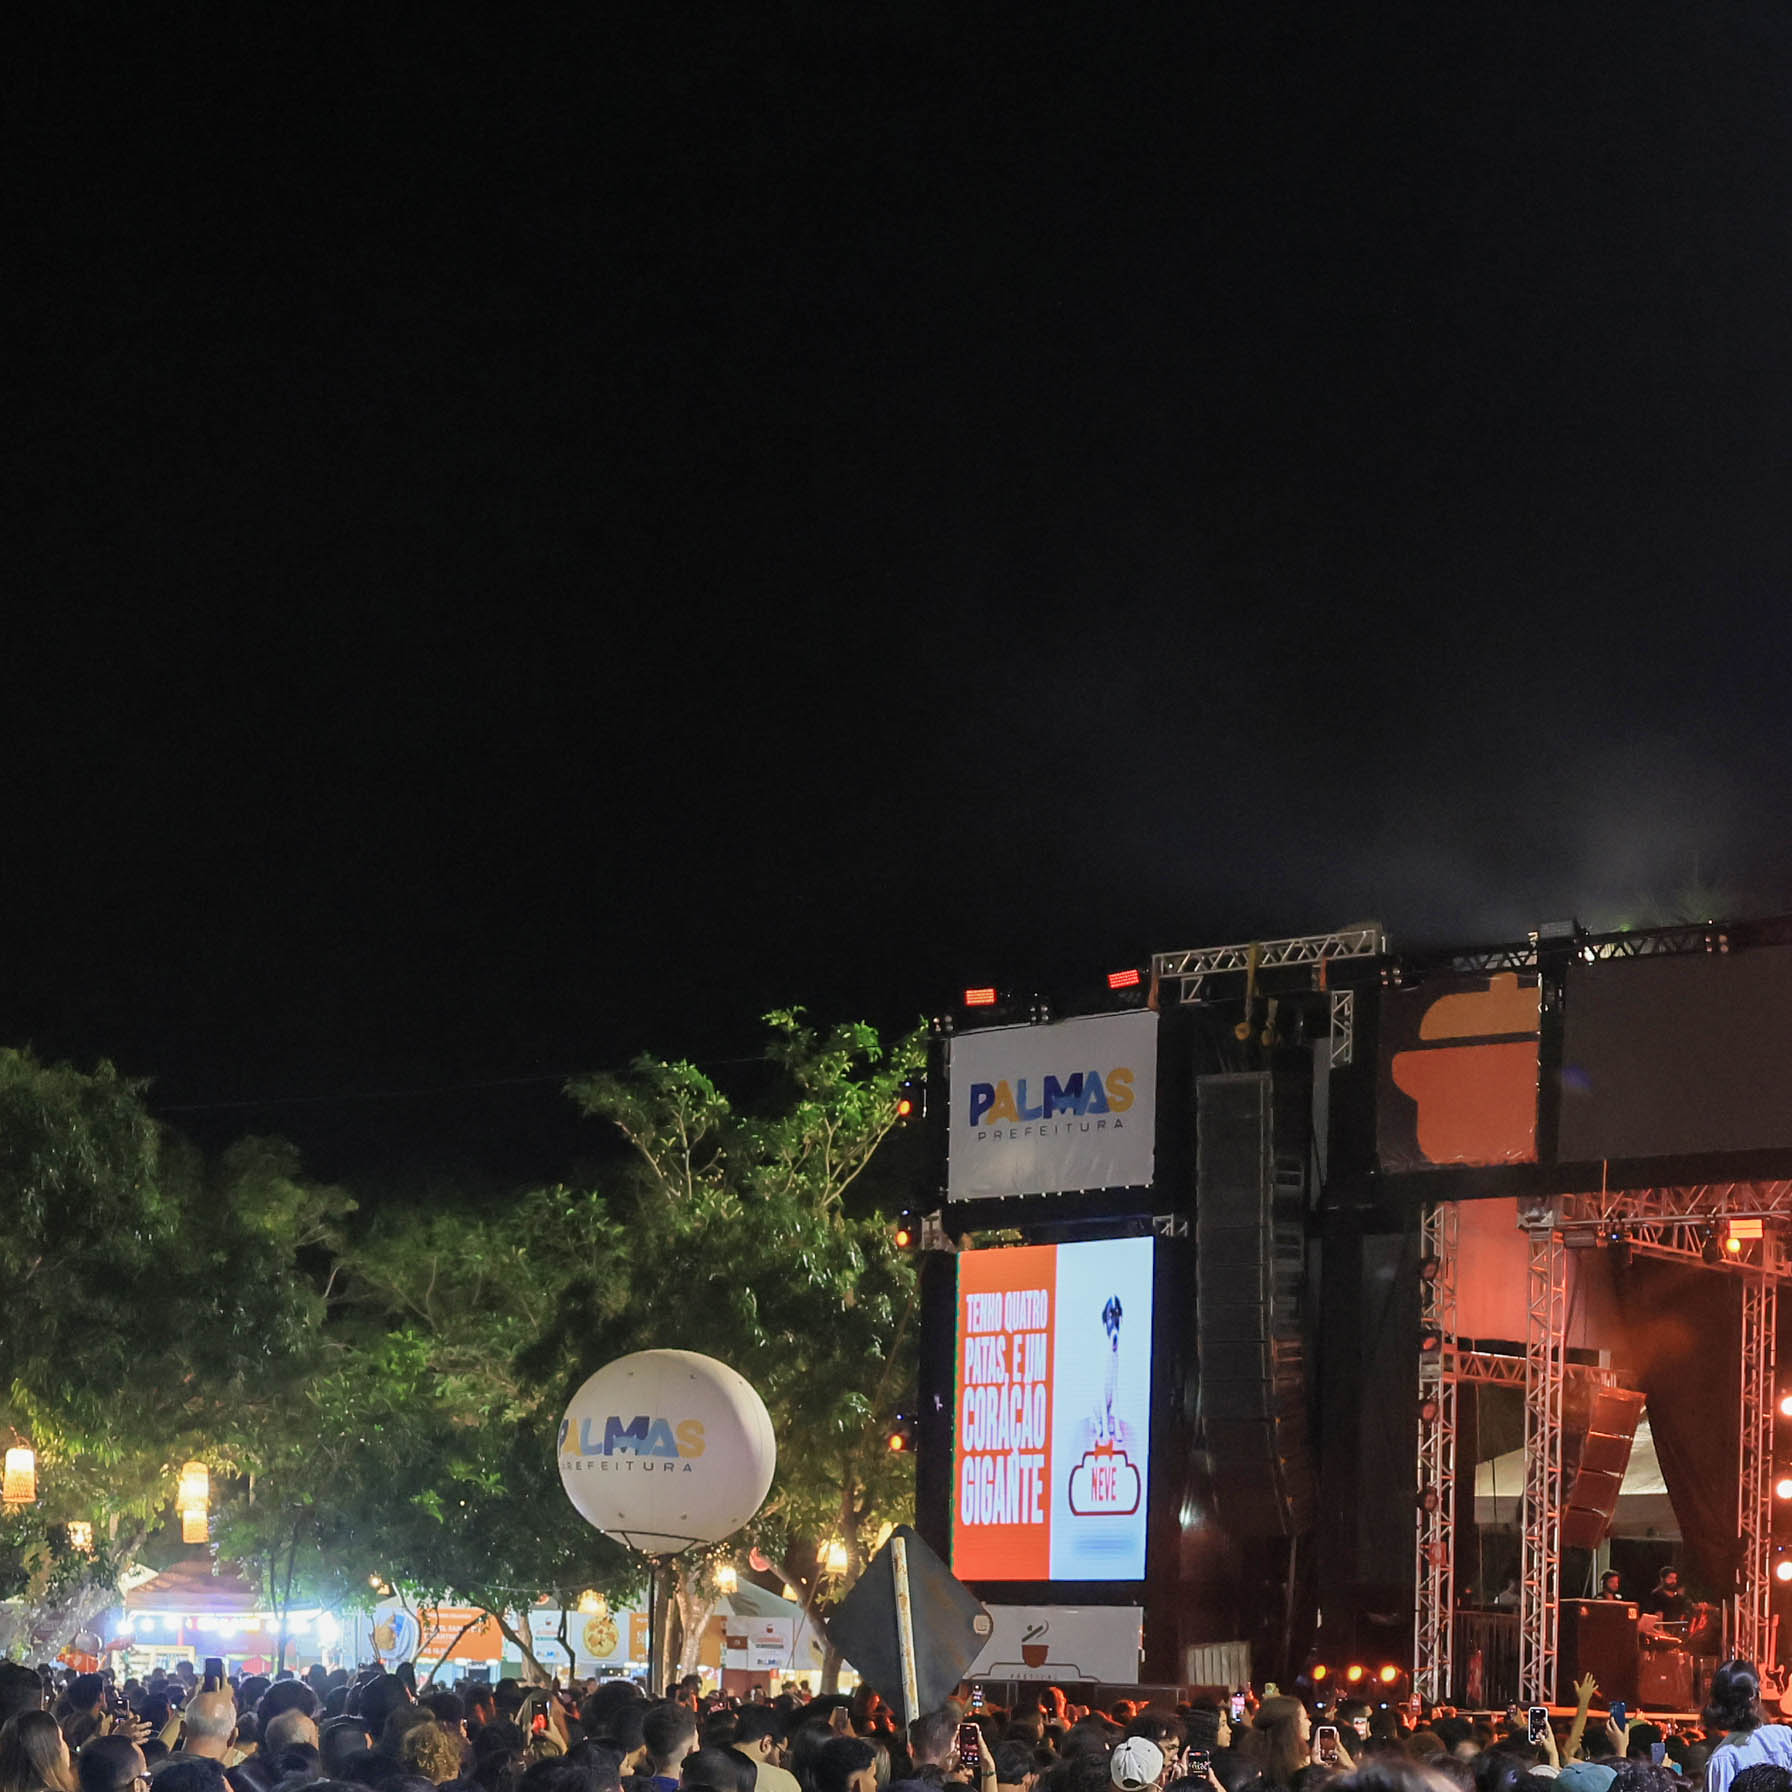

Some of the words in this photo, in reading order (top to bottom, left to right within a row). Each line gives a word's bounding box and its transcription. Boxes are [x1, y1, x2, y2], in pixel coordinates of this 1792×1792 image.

[969, 1067, 1135, 1127] PALMAS
[977, 1119, 1124, 1142] PREFEITURA
[966, 1292, 1003, 1333] TENHO
[1004, 1289, 1048, 1334] QUATRO
[965, 1335, 1008, 1386] PATAS,
[1012, 1334, 1023, 1383] E
[1024, 1333, 1047, 1384] UM
[962, 1382, 1047, 1454] CORAÇÃO
[961, 1454, 1045, 1525] GIGANTE
[1091, 1466, 1117, 1502] NEVE
